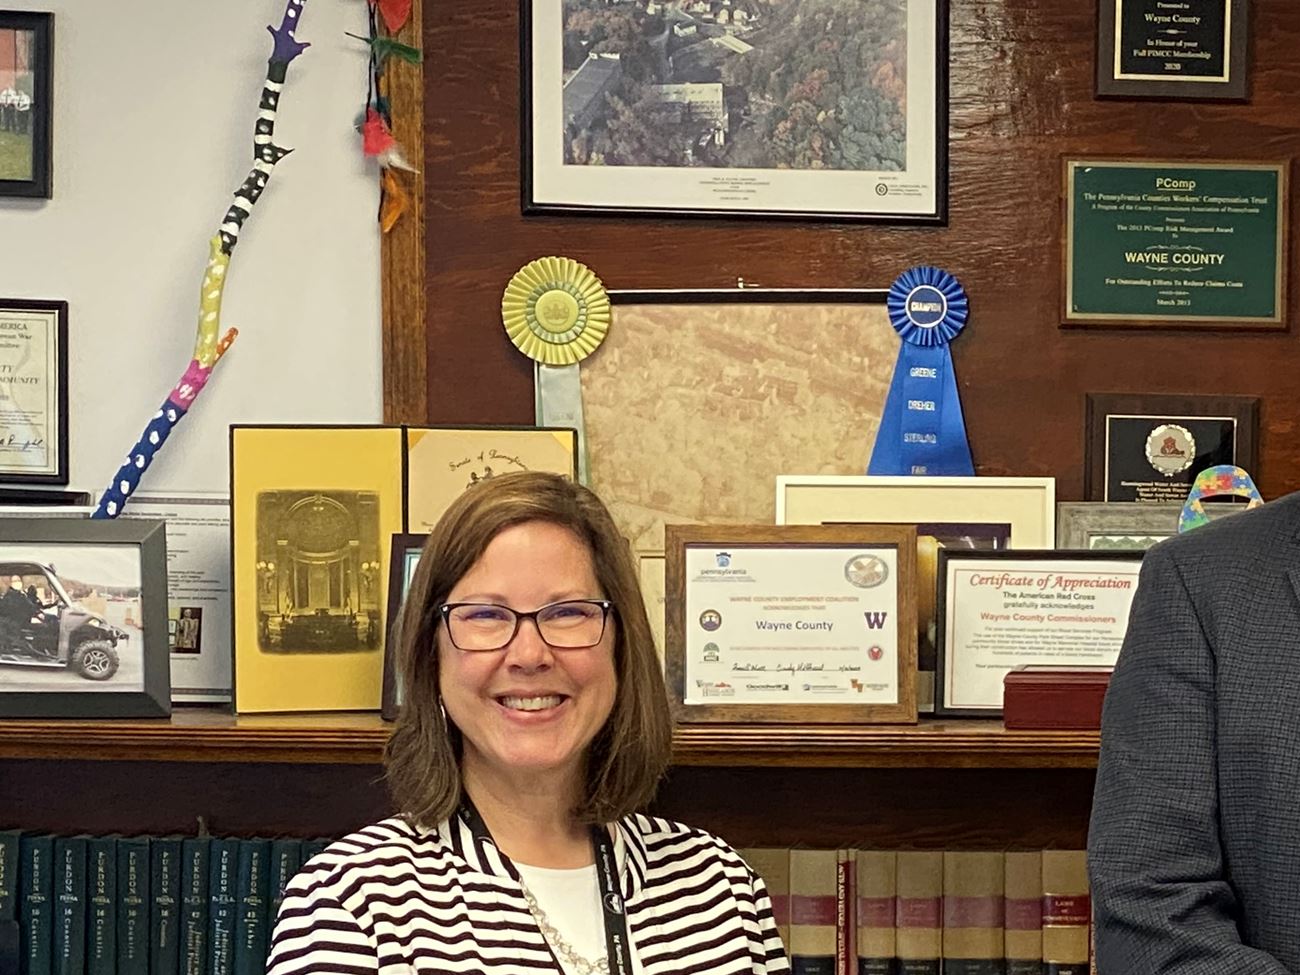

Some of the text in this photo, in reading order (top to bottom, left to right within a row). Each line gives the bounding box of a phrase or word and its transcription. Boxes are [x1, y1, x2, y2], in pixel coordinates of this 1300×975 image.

[1144, 13, 1201, 25] Wayne County
[1156, 178, 1196, 189] PComp
[1084, 192, 1096, 200] The
[1098, 193, 1141, 203] Pennsylvania
[1142, 194, 1171, 202] Counties
[1203, 195, 1249, 205] Compensation
[1251, 196, 1267, 204] Trust
[1125, 252, 1225, 265] WAYNE COUNTY
[911, 465, 927, 475] FAIR
[700, 568, 747, 576] pennsylvania
[969, 573, 1131, 591] Certificate of Appreciation
[1003, 591, 1096, 601] The American Red Cross
[1003, 601, 1095, 611] gratefully acknowledges
[864, 612, 887, 629] W
[980, 612, 1117, 624] Wayne County Commissioners
[756, 620, 834, 632] Wayne County
[129, 852, 137, 895] PURDON
[250, 852, 258, 894] PURDON
